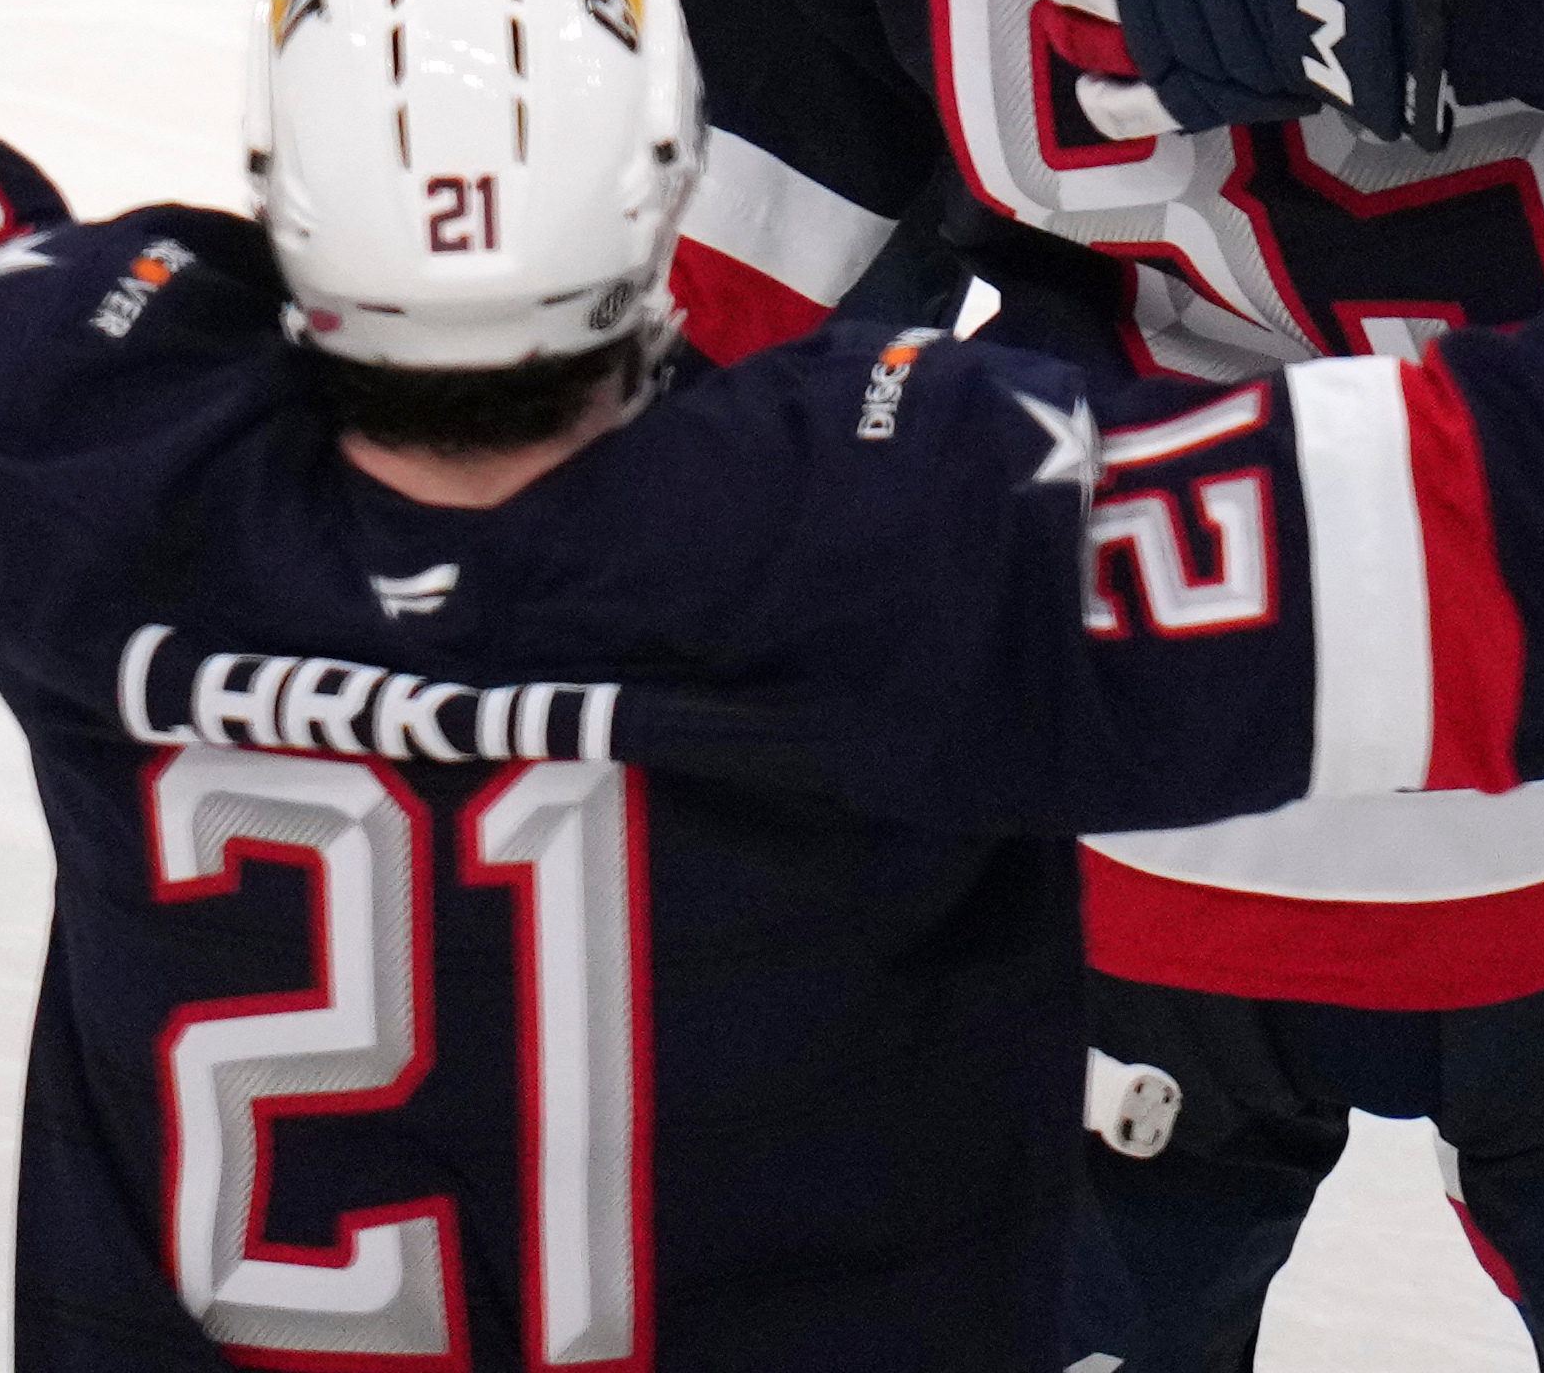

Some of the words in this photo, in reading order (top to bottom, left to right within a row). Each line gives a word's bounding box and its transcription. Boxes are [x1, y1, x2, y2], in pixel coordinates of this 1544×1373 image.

[426, 172, 500, 254] 21
[120, 623, 621, 764] LARKIN
[143, 743, 655, 1372] 21
